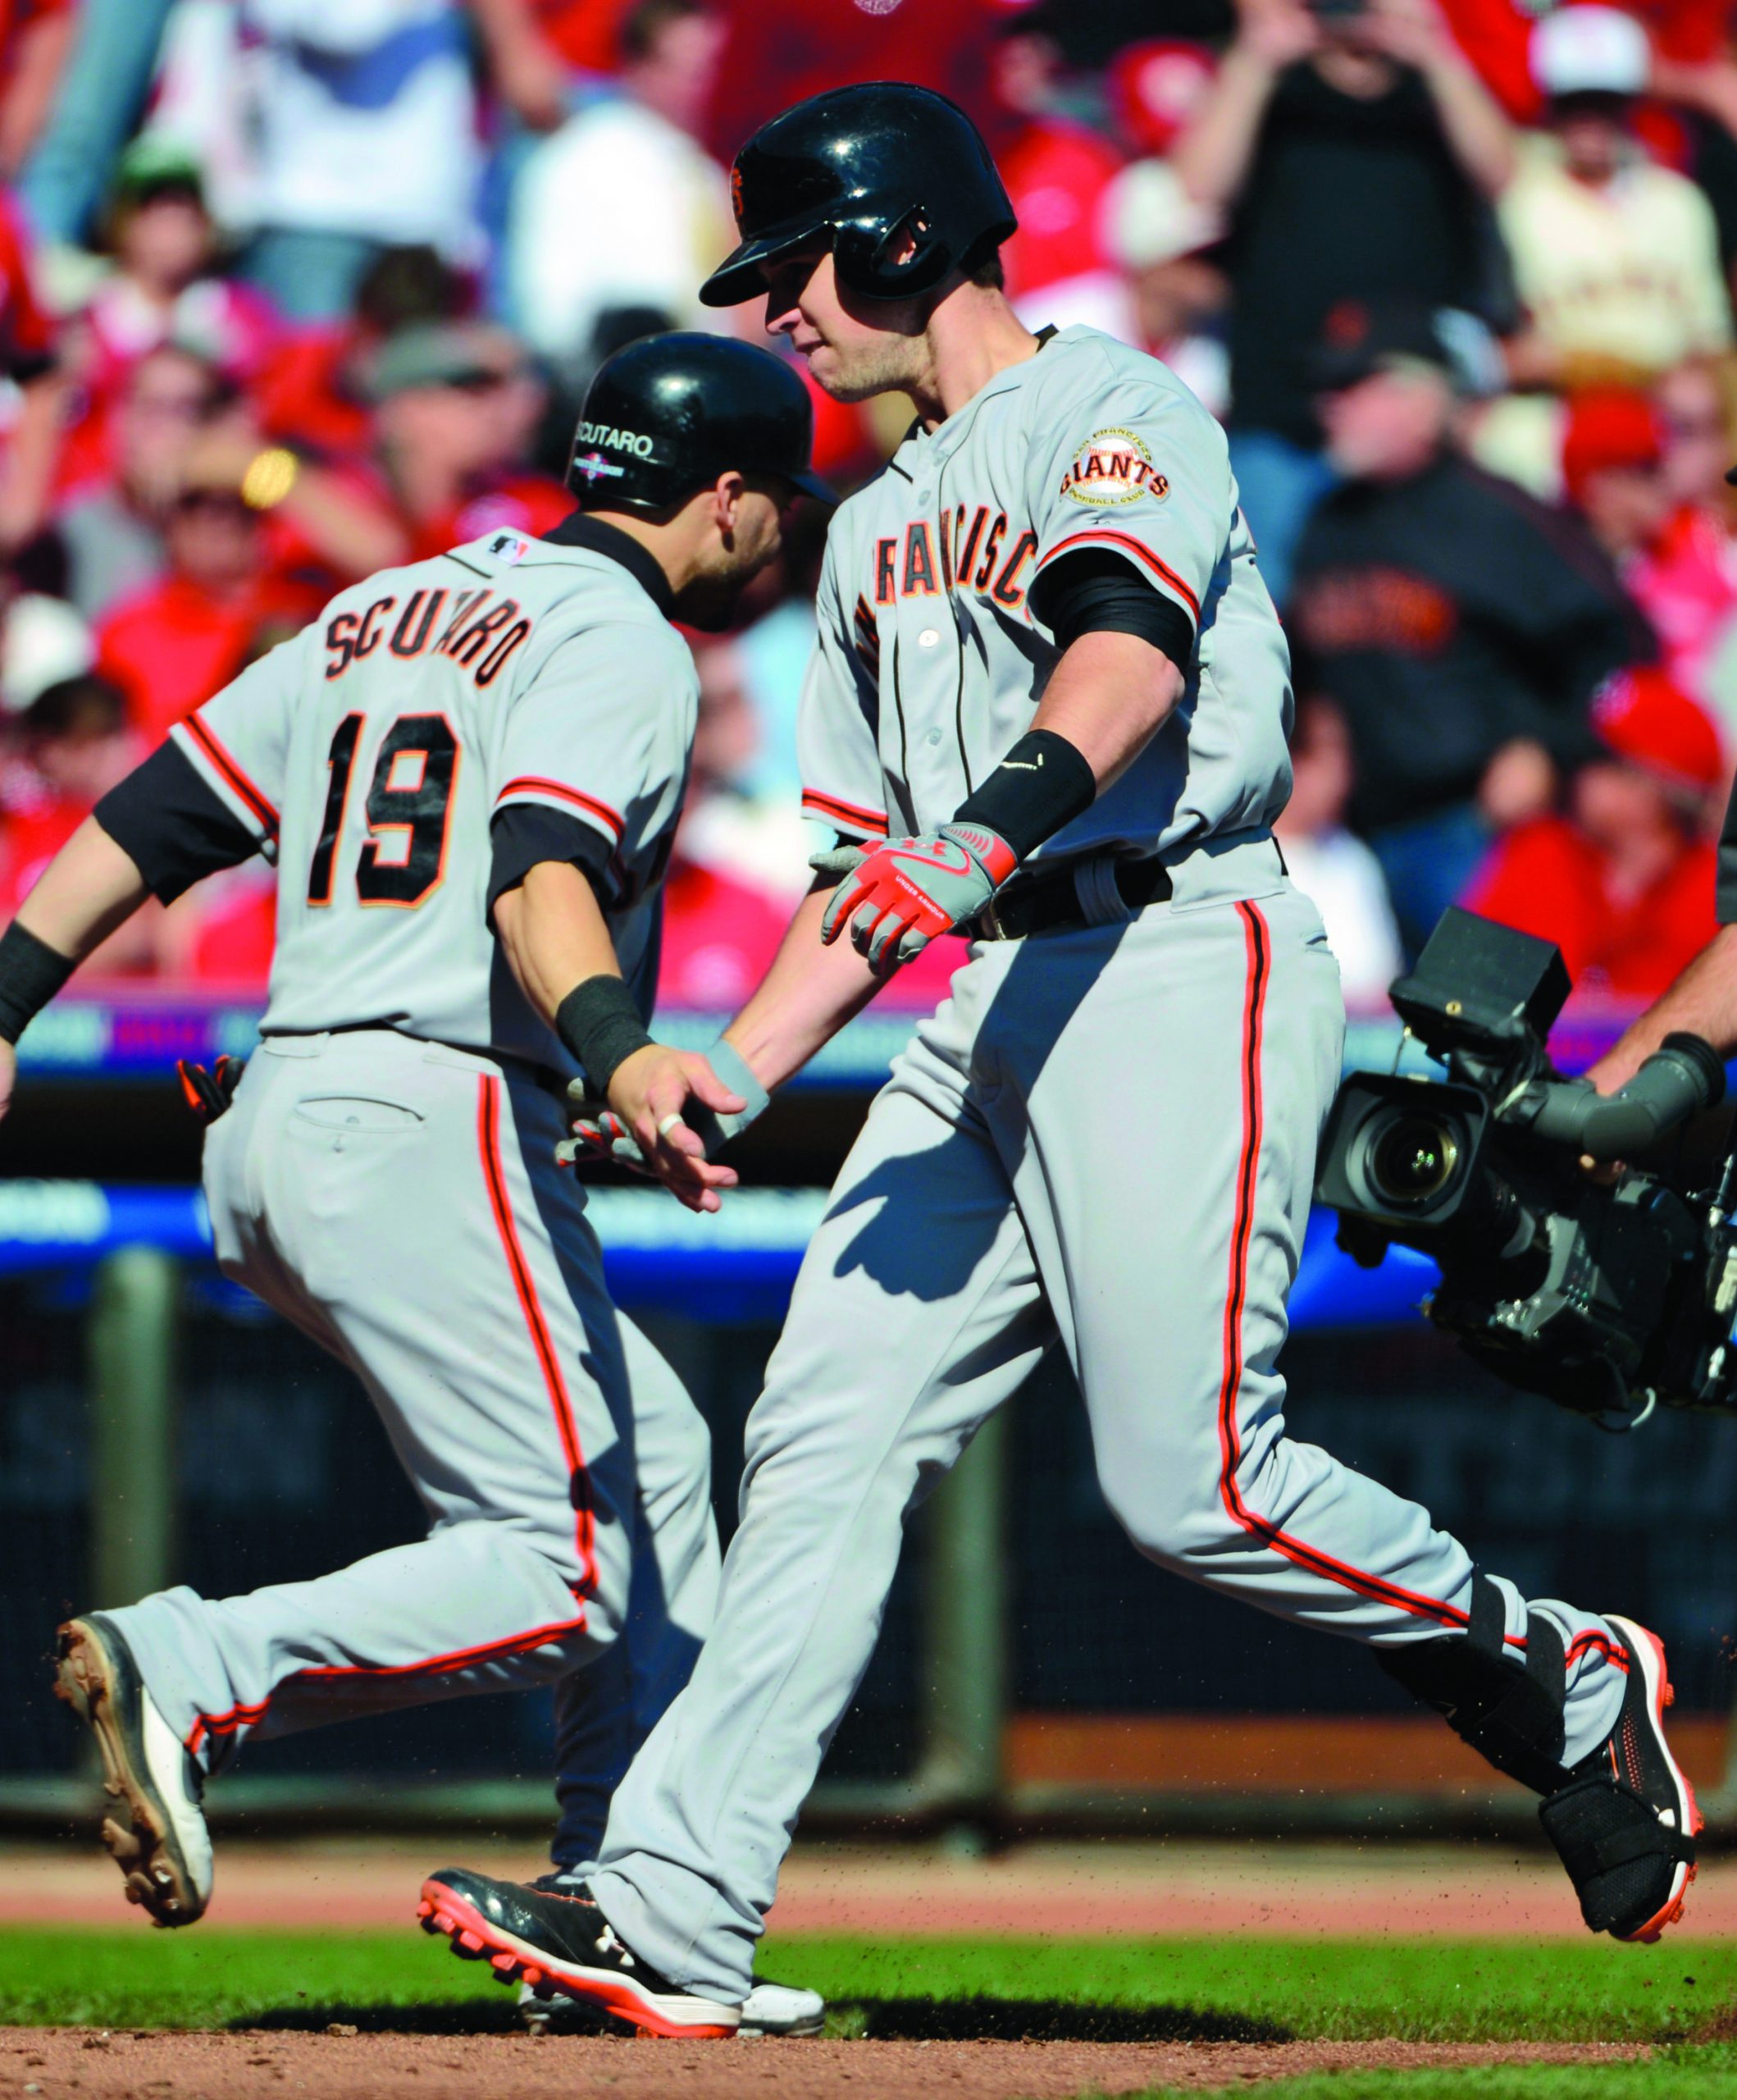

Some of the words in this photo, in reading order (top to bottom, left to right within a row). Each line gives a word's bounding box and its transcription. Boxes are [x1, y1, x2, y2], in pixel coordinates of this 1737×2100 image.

[1060, 452, 1169, 498] GIANTS
[1119, 488, 1146, 503] CLUB
[306, 710, 463, 910] 19
[896, 874, 918, 896] UNDER
[918, 895, 945, 920] ARMOUR
